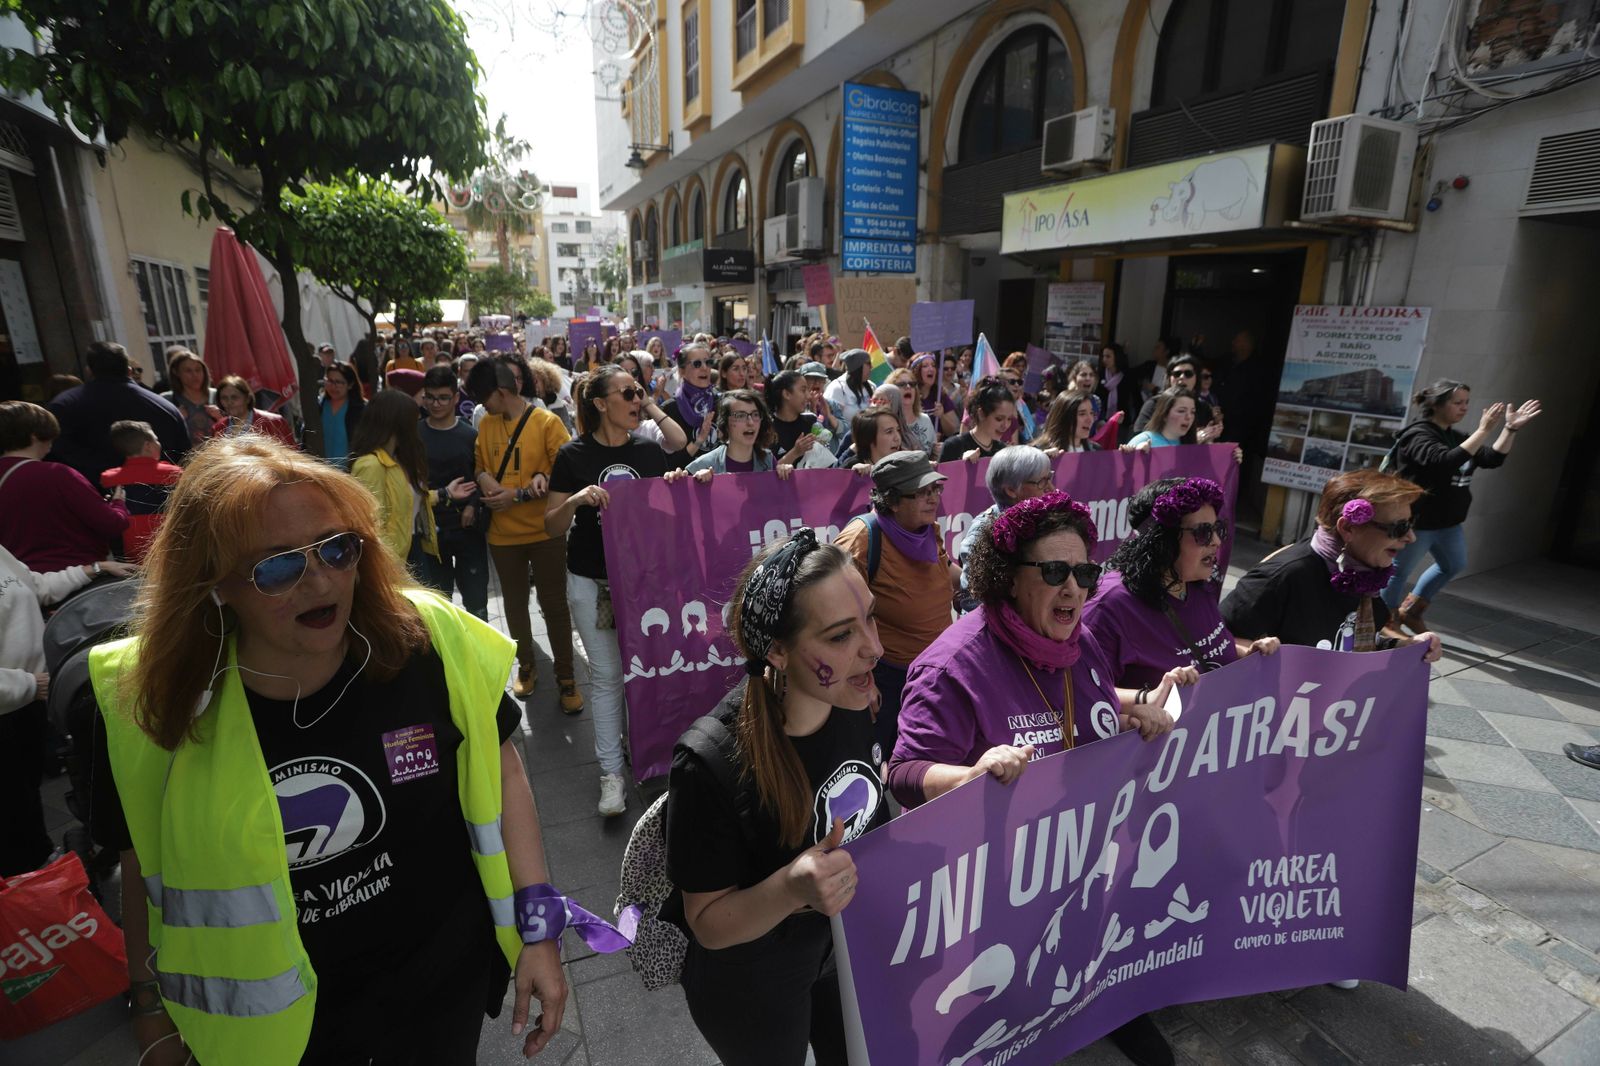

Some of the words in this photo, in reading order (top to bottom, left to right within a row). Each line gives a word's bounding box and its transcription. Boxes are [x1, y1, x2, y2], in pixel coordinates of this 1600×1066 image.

[848, 88, 918, 116] Gibralcop
[852, 136, 876, 147] Regalos
[852, 151, 874, 162] Ofertas
[852, 166, 882, 177] Camisetas
[885, 186, 904, 196] Planos
[852, 199, 869, 209] Sellos
[870, 202, 878, 210] de
[878, 201, 900, 211] Caucho
[845, 240, 901, 254] IMPRENTA
[846, 257, 913, 270] COPISTERIA
[1295, 306, 1329, 317] Edif.
[1339, 306, 1422, 318] LLODRA
[1316, 331, 1403, 341] DORMITORIOS
[1339, 341, 1372, 350] BAÑO
[1315, 351, 1377, 361] ASCENSOR
[383, 739, 408, 749] Huelga
[408, 732, 435, 743] Feminista
[1012, 723, 1079, 747] AGRESI
[270, 762, 342, 785] MINISMO
[820, 764, 858, 799] FEMINISMO
[889, 842, 989, 966] ¡NI
[1009, 801, 1097, 907] UN
[1188, 683, 1375, 778] ATRÁS!
[1247, 852, 1338, 888] MAREA
[302, 907, 321, 924] DE
[325, 874, 392, 919] GIBRALTAR
[1239, 887, 1342, 928] VIOLETA
[1234, 934, 1271, 950] CAMPO
[1274, 932, 1287, 945] DE
[1291, 926, 1344, 943] GIBRALTAR
[983, 1028, 1043, 1066] inista
